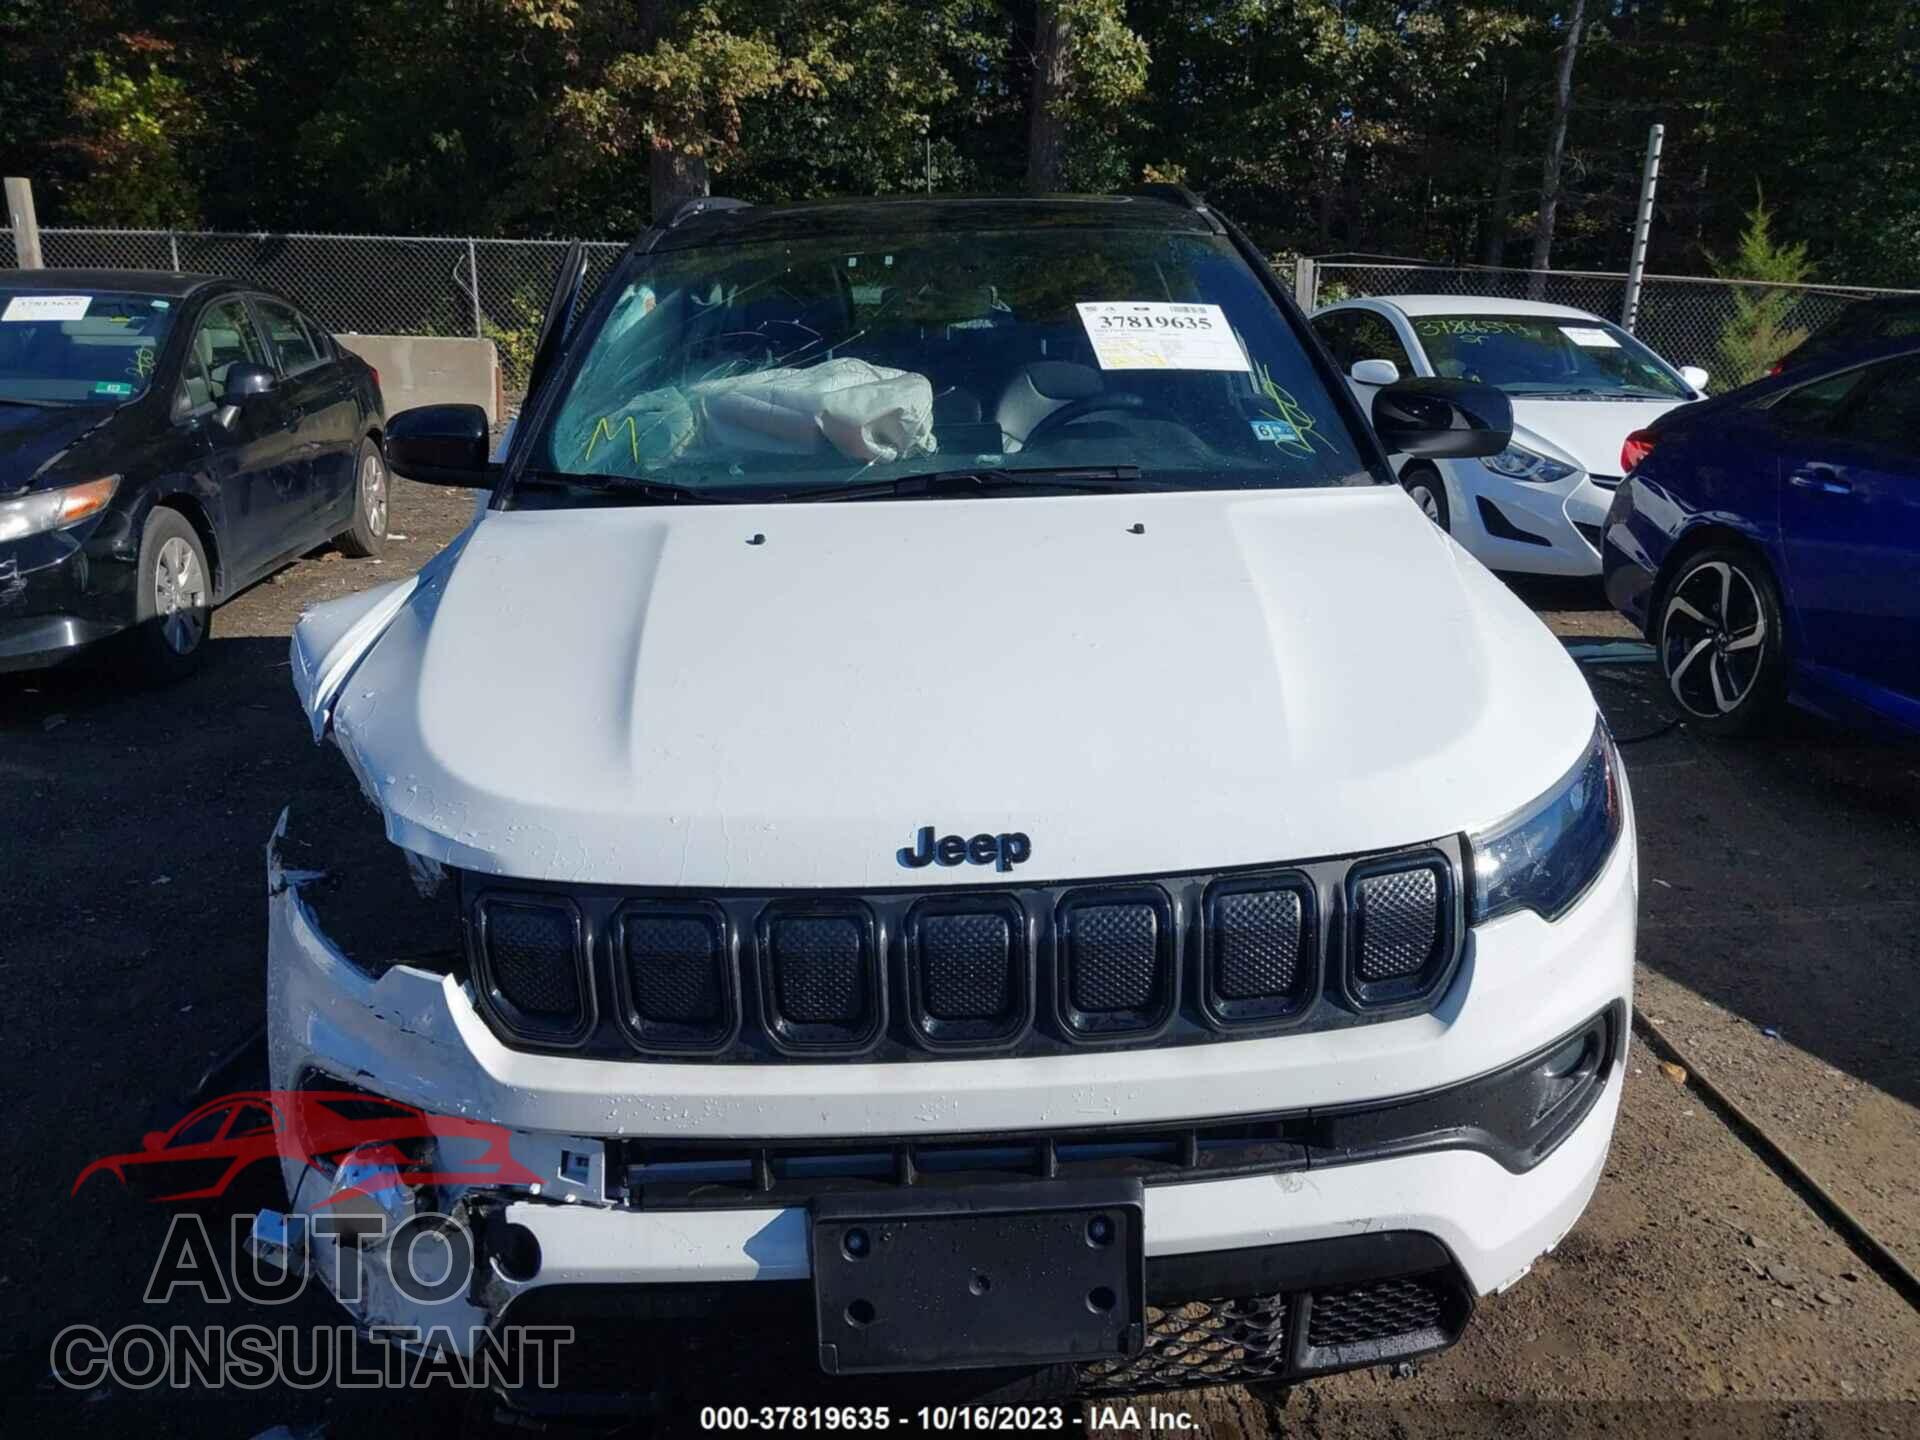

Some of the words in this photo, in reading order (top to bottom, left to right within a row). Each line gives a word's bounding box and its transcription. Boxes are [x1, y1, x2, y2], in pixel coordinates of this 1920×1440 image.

[1099, 315, 1213, 330] 37819635
[584, 416, 640, 463] M
[896, 825, 1033, 873] Jeep
